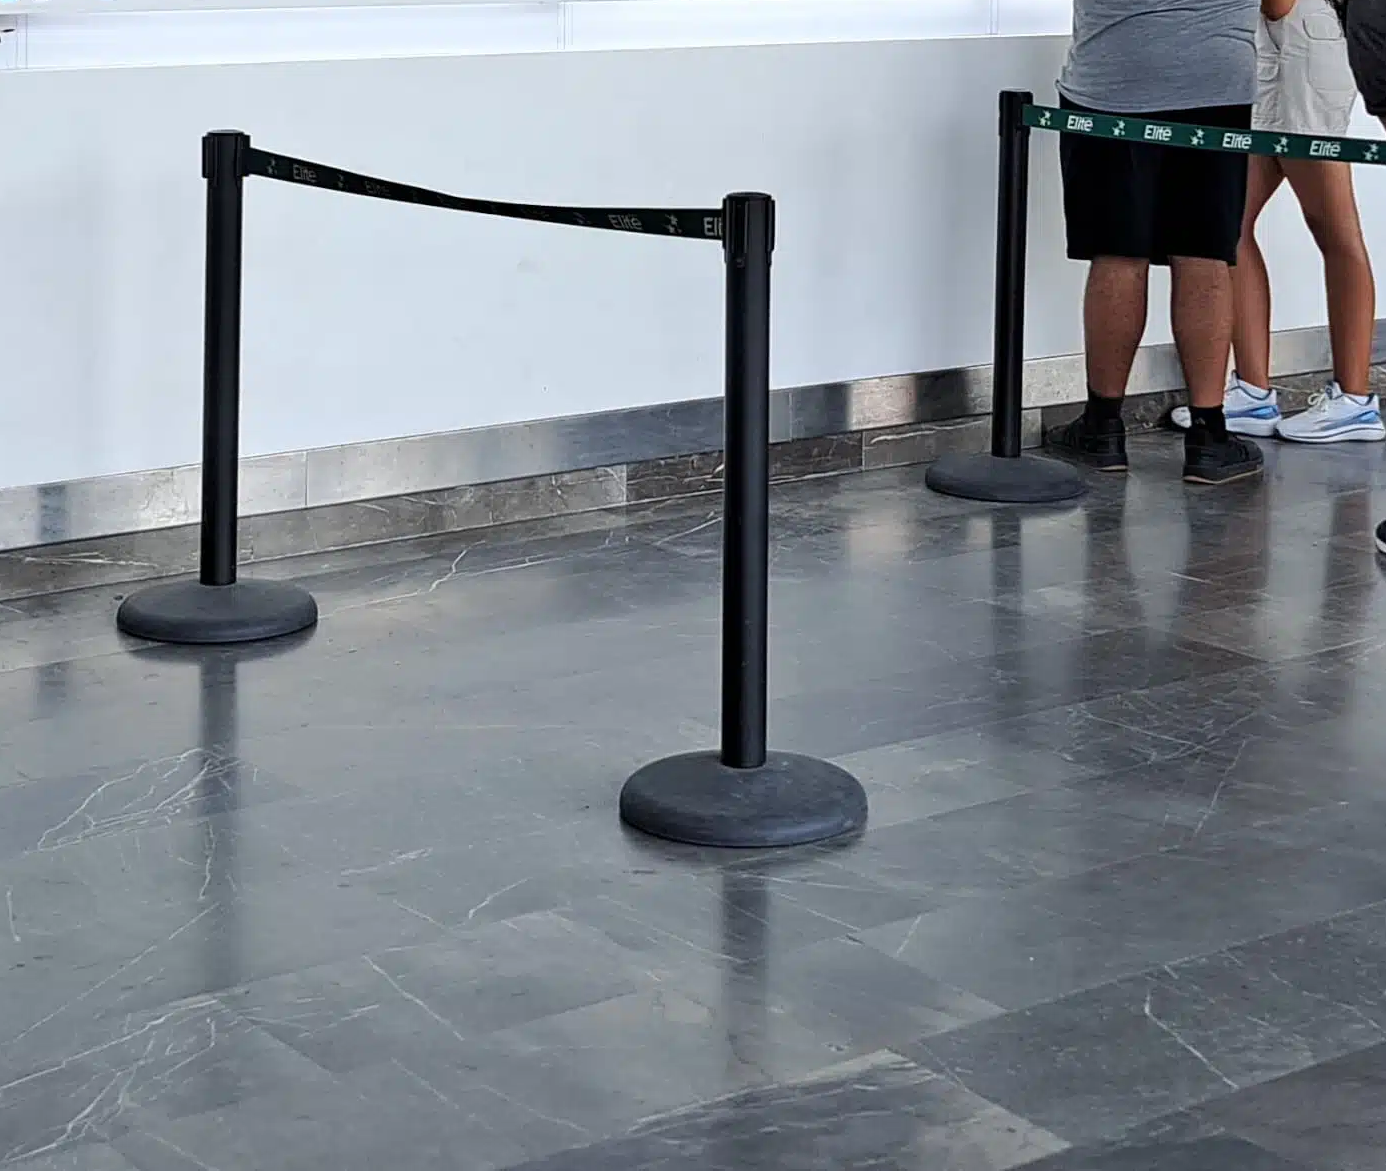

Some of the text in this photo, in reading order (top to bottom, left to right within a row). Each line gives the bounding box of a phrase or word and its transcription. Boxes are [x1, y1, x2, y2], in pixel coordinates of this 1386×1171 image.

[1066, 114, 1094, 132] Elite
[1143, 124, 1173, 141] Elite
[1222, 132, 1252, 150] Elite
[1309, 140, 1341, 157] Elite
